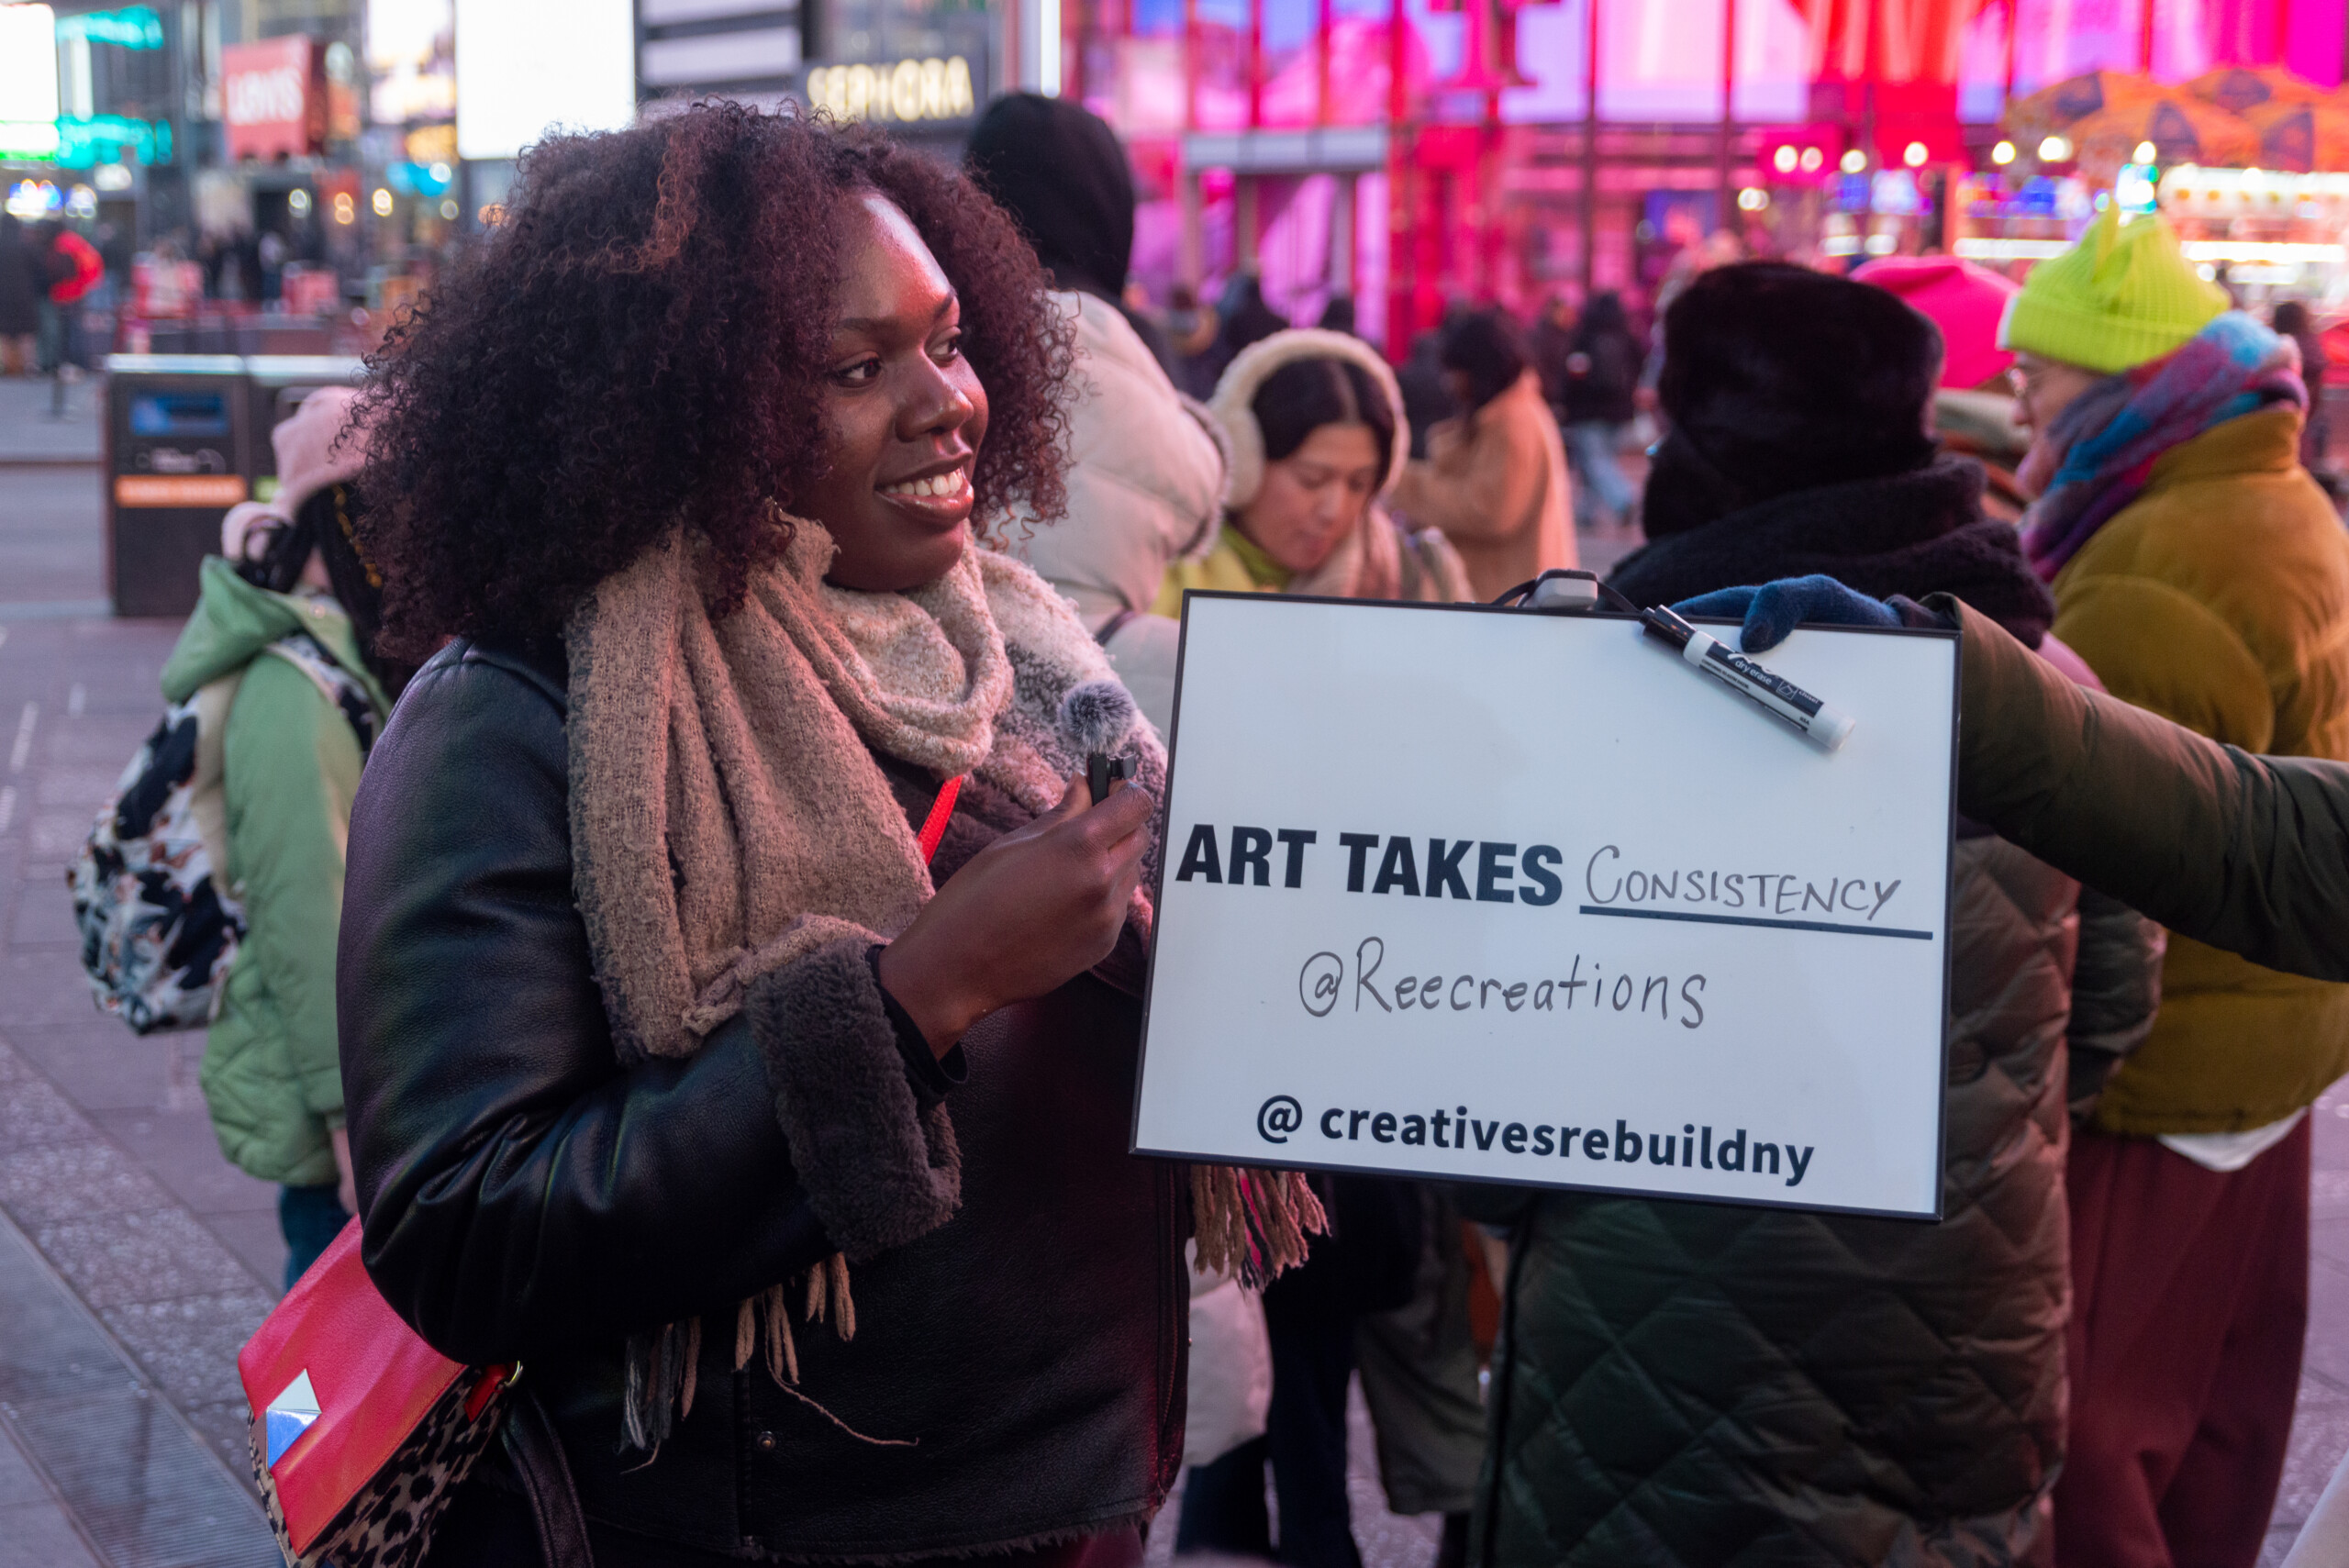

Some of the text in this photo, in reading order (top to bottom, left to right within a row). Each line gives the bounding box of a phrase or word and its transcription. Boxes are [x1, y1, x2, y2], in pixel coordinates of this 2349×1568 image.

[1734, 659, 1772, 685] dry erase
[1175, 823, 1902, 921] ART TAKES CONSISTENCY
[1298, 936, 1707, 1029] @Reecreations
[1256, 1095, 1815, 1187] @ creativesrebuildny
